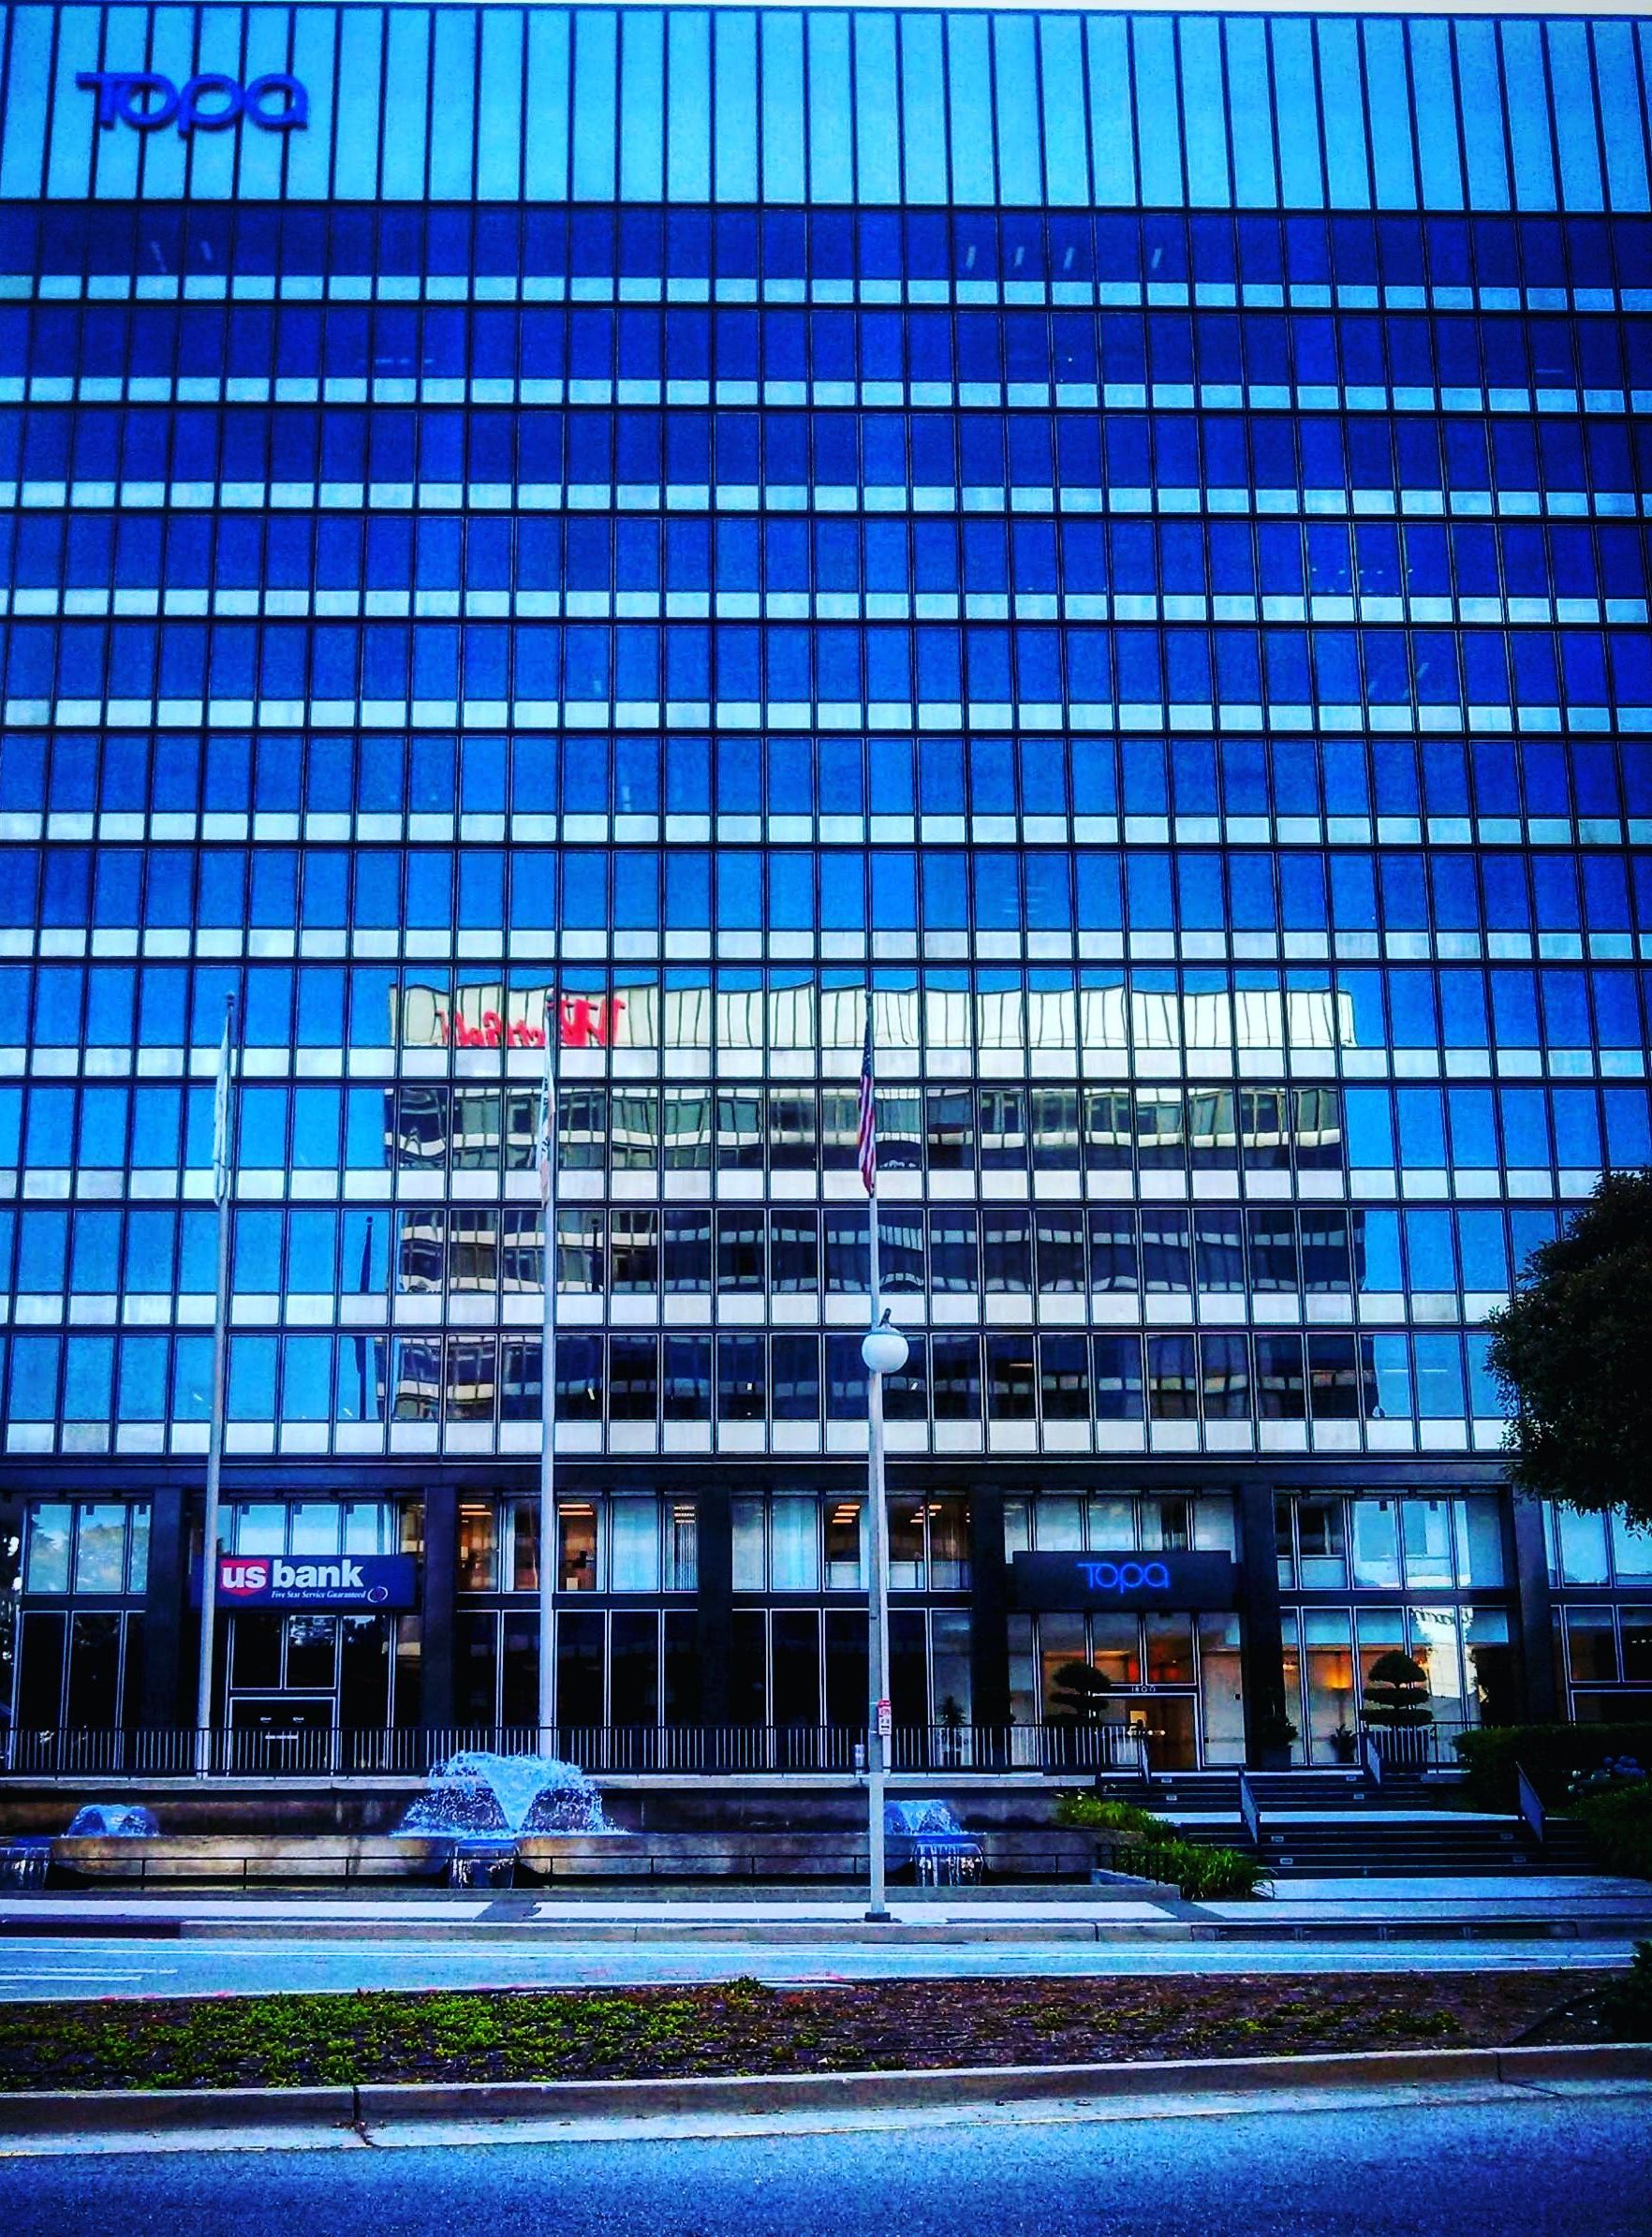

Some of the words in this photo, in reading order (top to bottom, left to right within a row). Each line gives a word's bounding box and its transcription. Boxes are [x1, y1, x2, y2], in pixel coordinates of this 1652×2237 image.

[272, 1559, 364, 1588] bank
[271, 1590, 285, 1598] Five
[287, 1590, 300, 1598] Star
[301, 1590, 325, 1598] Service
[327, 1590, 366, 1598] Guaranteed
